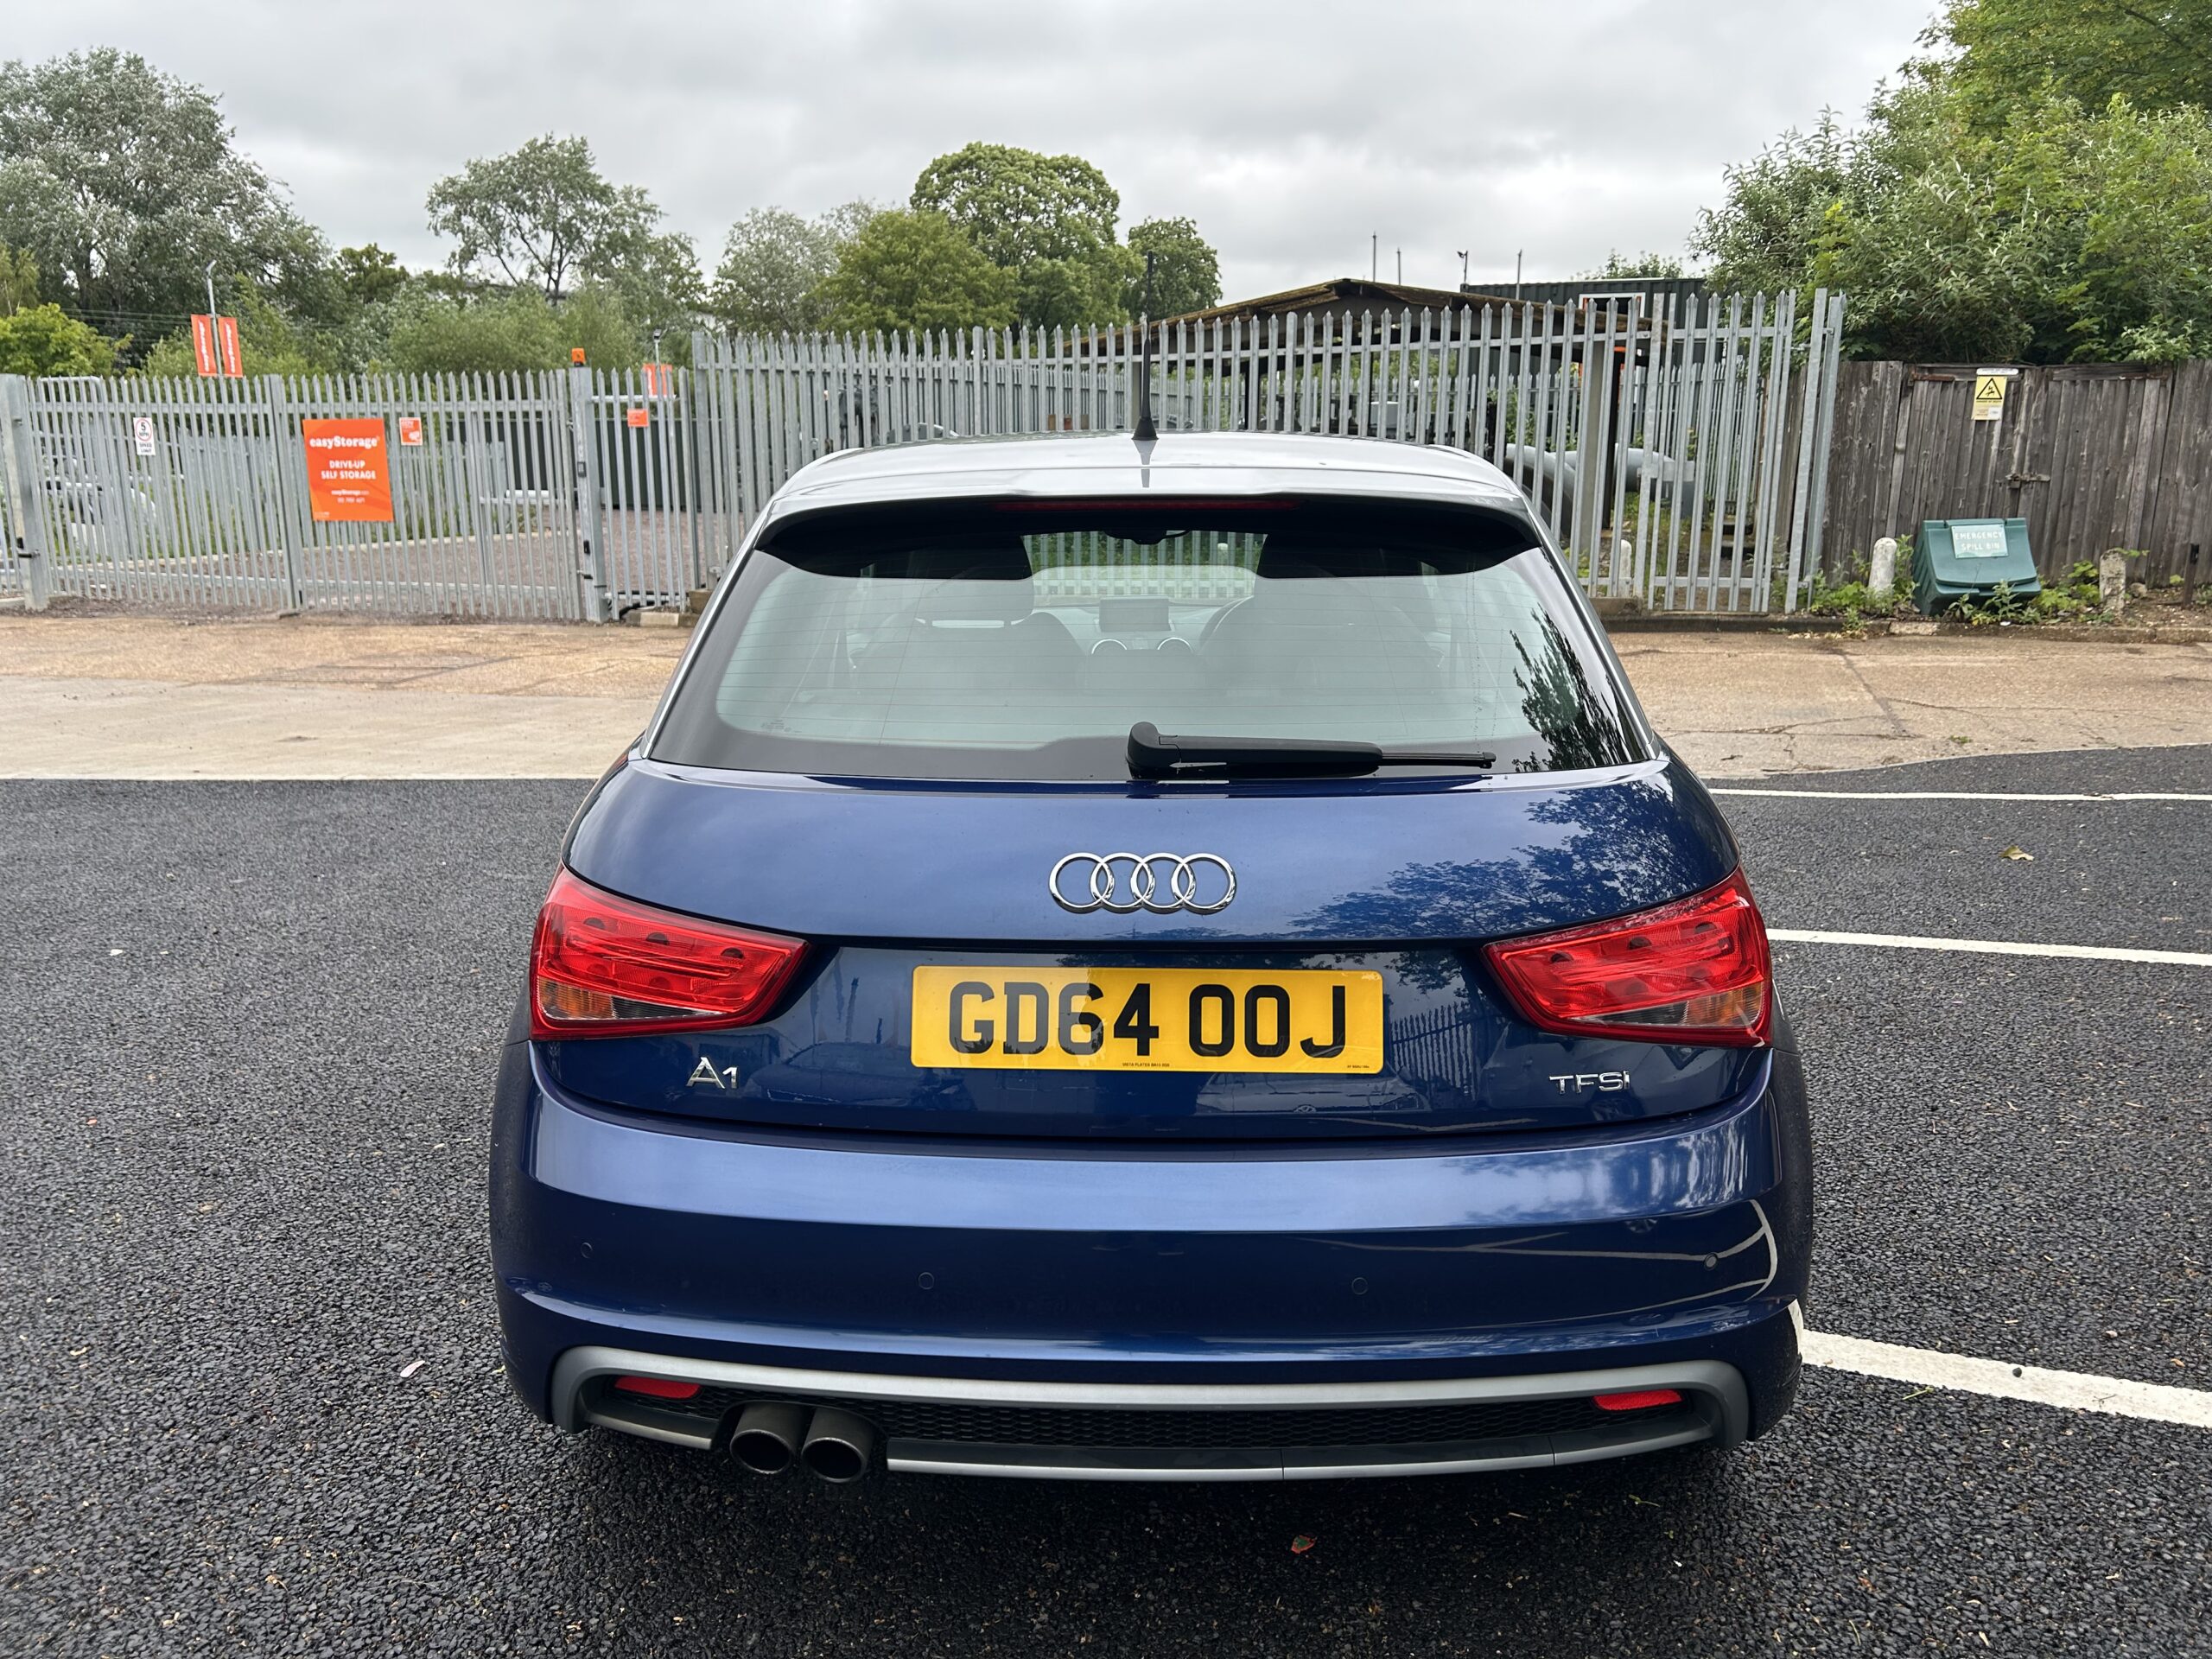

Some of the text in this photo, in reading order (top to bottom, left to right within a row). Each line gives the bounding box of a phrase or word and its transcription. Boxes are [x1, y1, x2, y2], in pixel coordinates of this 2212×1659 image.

[140, 422, 146, 431] 5
[309, 435, 378, 449] easyStorage
[329, 460, 365, 469] DRIVE-UP
[321, 470, 376, 480] SELF STORAGE
[1955, 531, 2002, 540] EMERGENCY
[1961, 543, 1983, 551] SPILL
[950, 981, 1346, 1058] GD64 OOJ
[685, 1057, 738, 1089] A1
